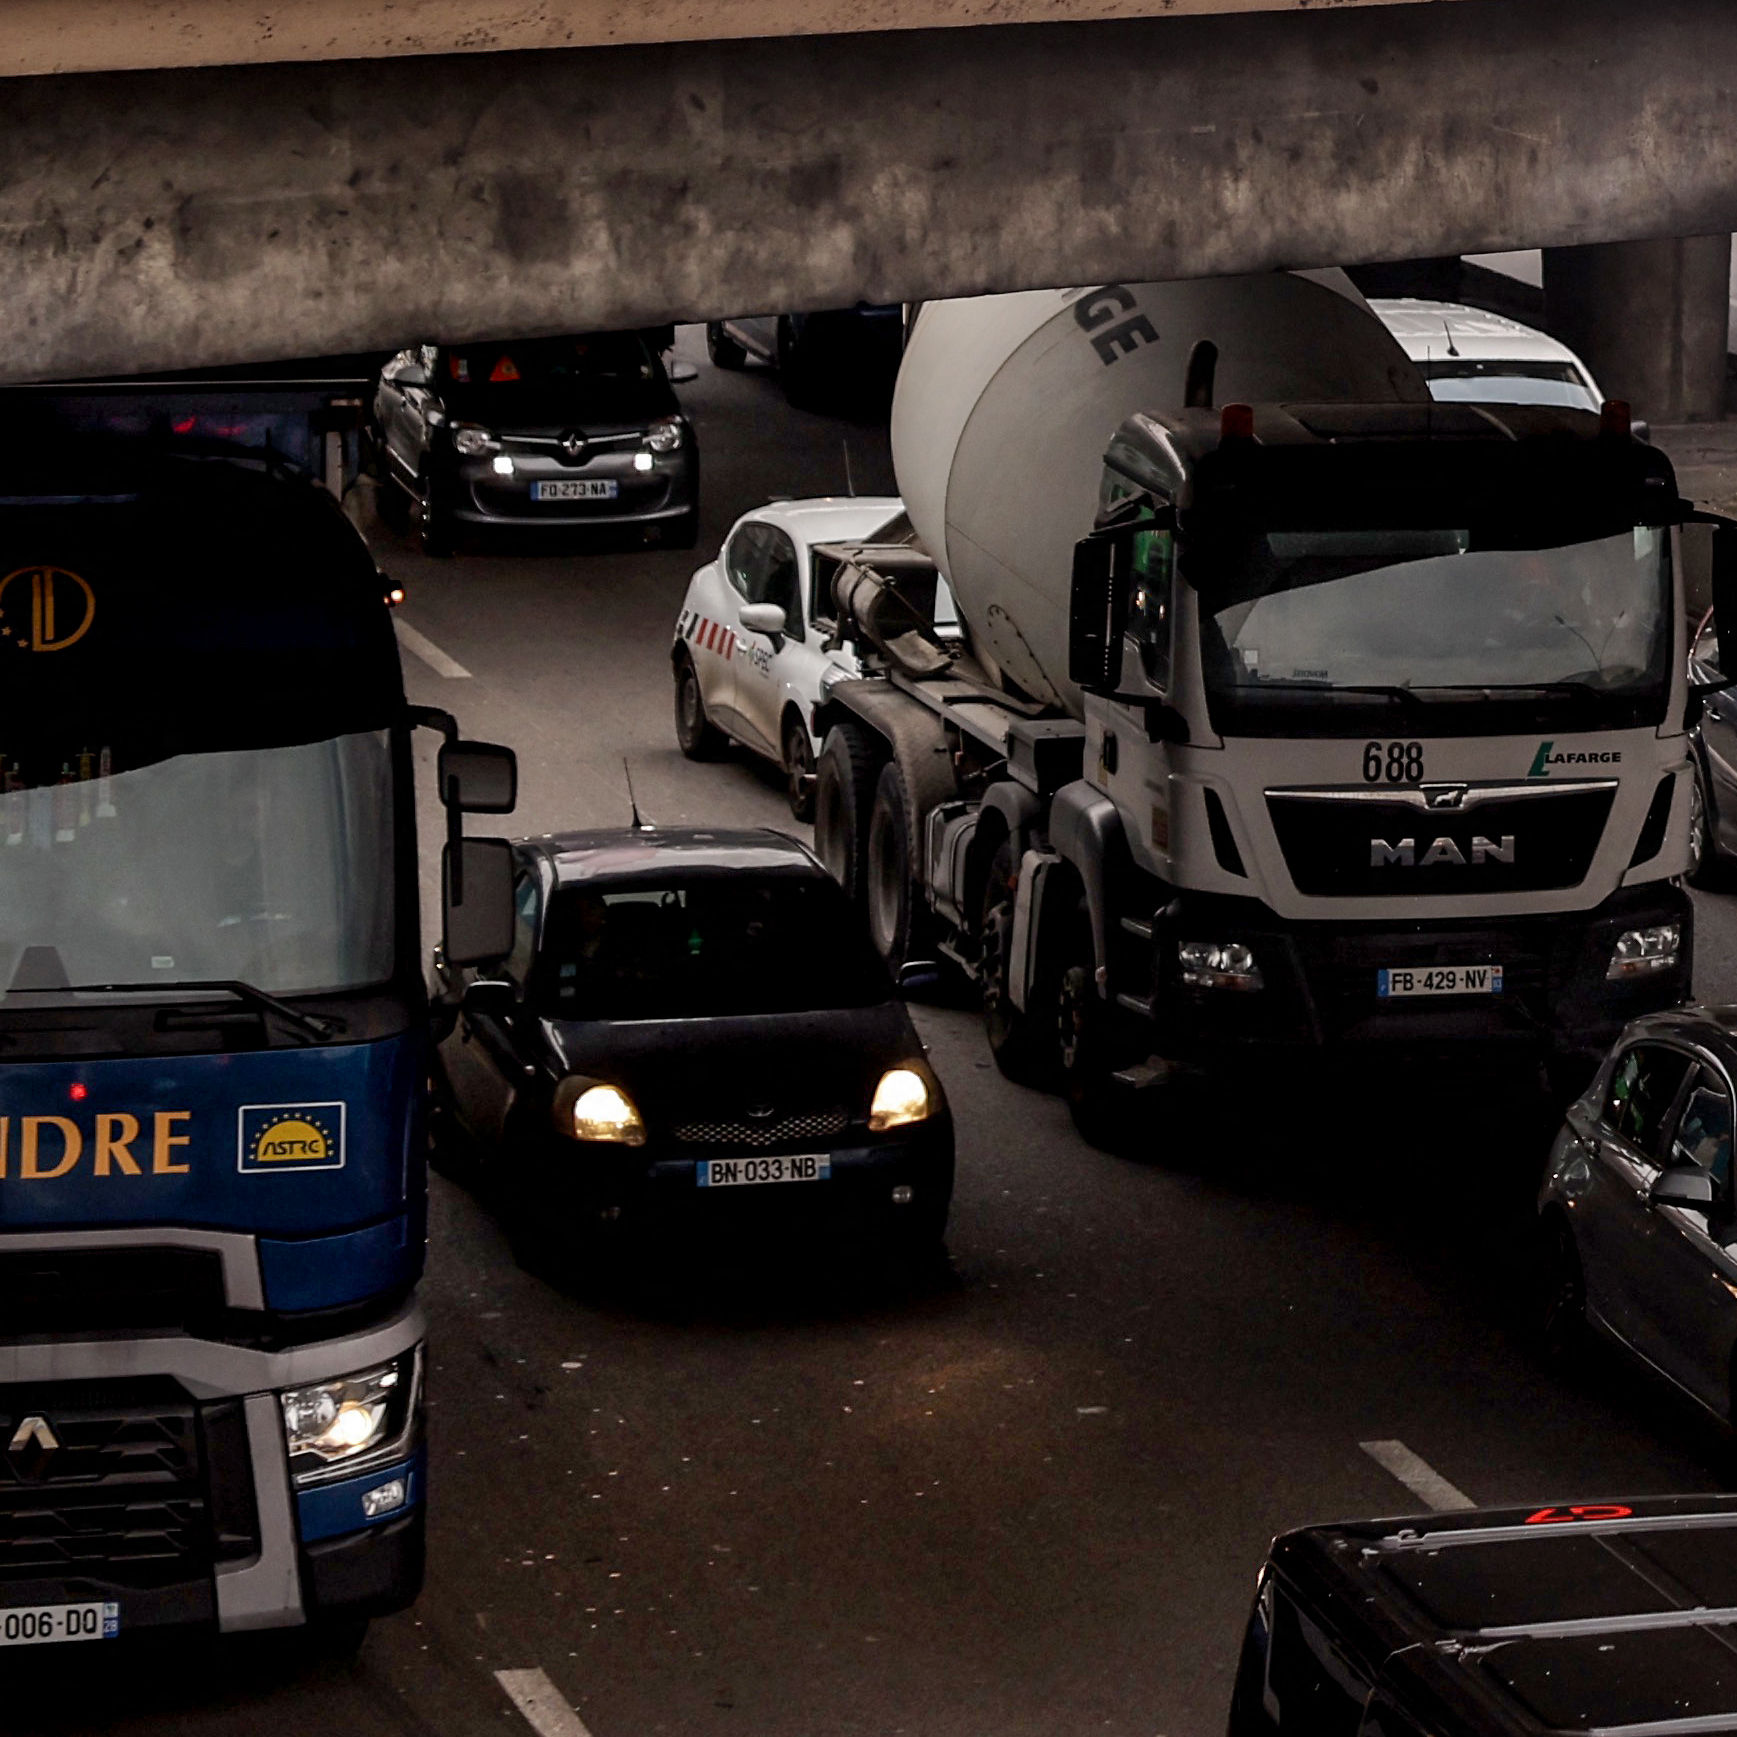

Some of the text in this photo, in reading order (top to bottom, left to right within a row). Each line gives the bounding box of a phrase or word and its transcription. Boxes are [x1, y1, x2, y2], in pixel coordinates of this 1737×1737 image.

[1062, 285, 1160, 366] GE
[1362, 741, 1424, 782] 688
[1544, 752, 1622, 764] LAFARGE
[1370, 835, 1516, 867] MAN
[1391, 969, 1487, 992] FB-429-NV
[711, 1157, 817, 1184] BN-033-NB
